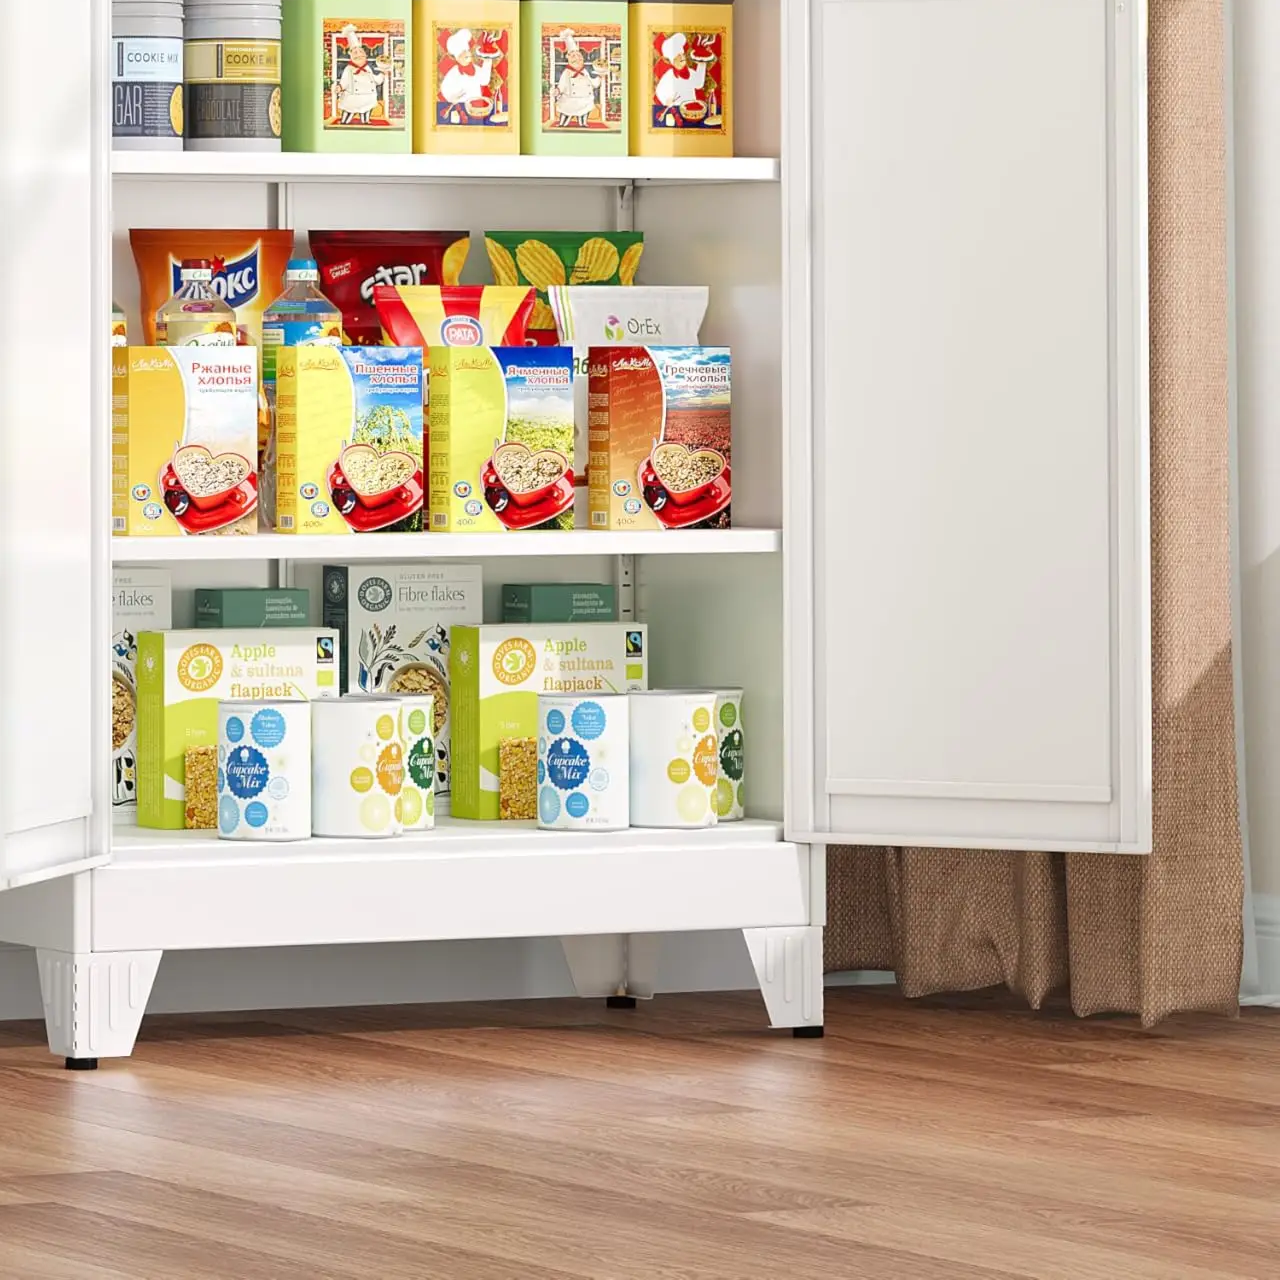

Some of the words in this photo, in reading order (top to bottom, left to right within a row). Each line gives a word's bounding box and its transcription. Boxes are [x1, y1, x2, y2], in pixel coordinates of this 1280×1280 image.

[127, 52, 165, 63] COOKIE
[226, 54, 264, 64] COOKIE
[114, 84, 142, 126] GAR
[627, 318, 661, 336] OrEx
[191, 362, 252, 374] Ржаные
[355, 364, 417, 374] Пшенные
[507, 367, 569, 376] Ячменные
[665, 364, 727, 375] Гречневые
[198, 375, 251, 385] хлопья
[371, 375, 417, 384] хлопья
[527, 376, 568, 384] хлопья
[686, 374, 727, 383] хлопья
[119, 590, 154, 606] flakes
[399, 586, 428, 601] Fibre
[431, 585, 465, 601] flakes
[230, 643, 276, 661] Apple
[543, 638, 587, 654] Apple
[230, 665, 243, 678] &
[248, 663, 304, 678] sultana
[543, 659, 554, 671] &
[559, 657, 614, 671] sultana
[230, 682, 293, 700] flapjack
[543, 677, 603, 693] flapjack
[548, 753, 587, 768] Cupcake
[227, 761, 266, 777] Cupcake
[560, 766, 582, 780] Mix
[239, 775, 261, 789] Mix
